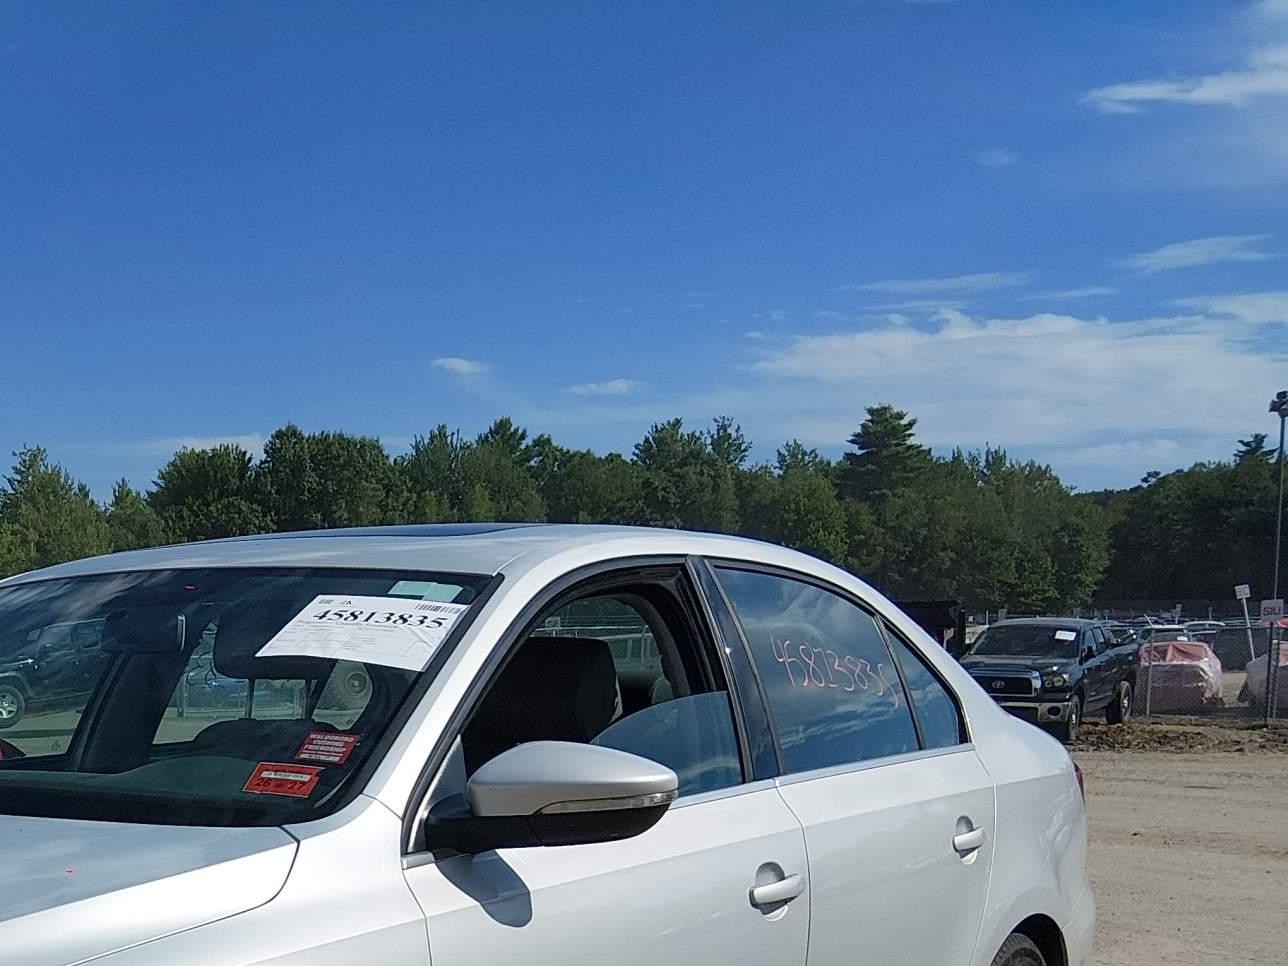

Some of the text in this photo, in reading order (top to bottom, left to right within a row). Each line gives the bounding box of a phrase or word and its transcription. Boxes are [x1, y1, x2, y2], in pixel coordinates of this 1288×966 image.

[1263, 606, 1281, 616] SIU
[313, 609, 448, 629] 45813835
[255, 779, 308, 791] 26 27
